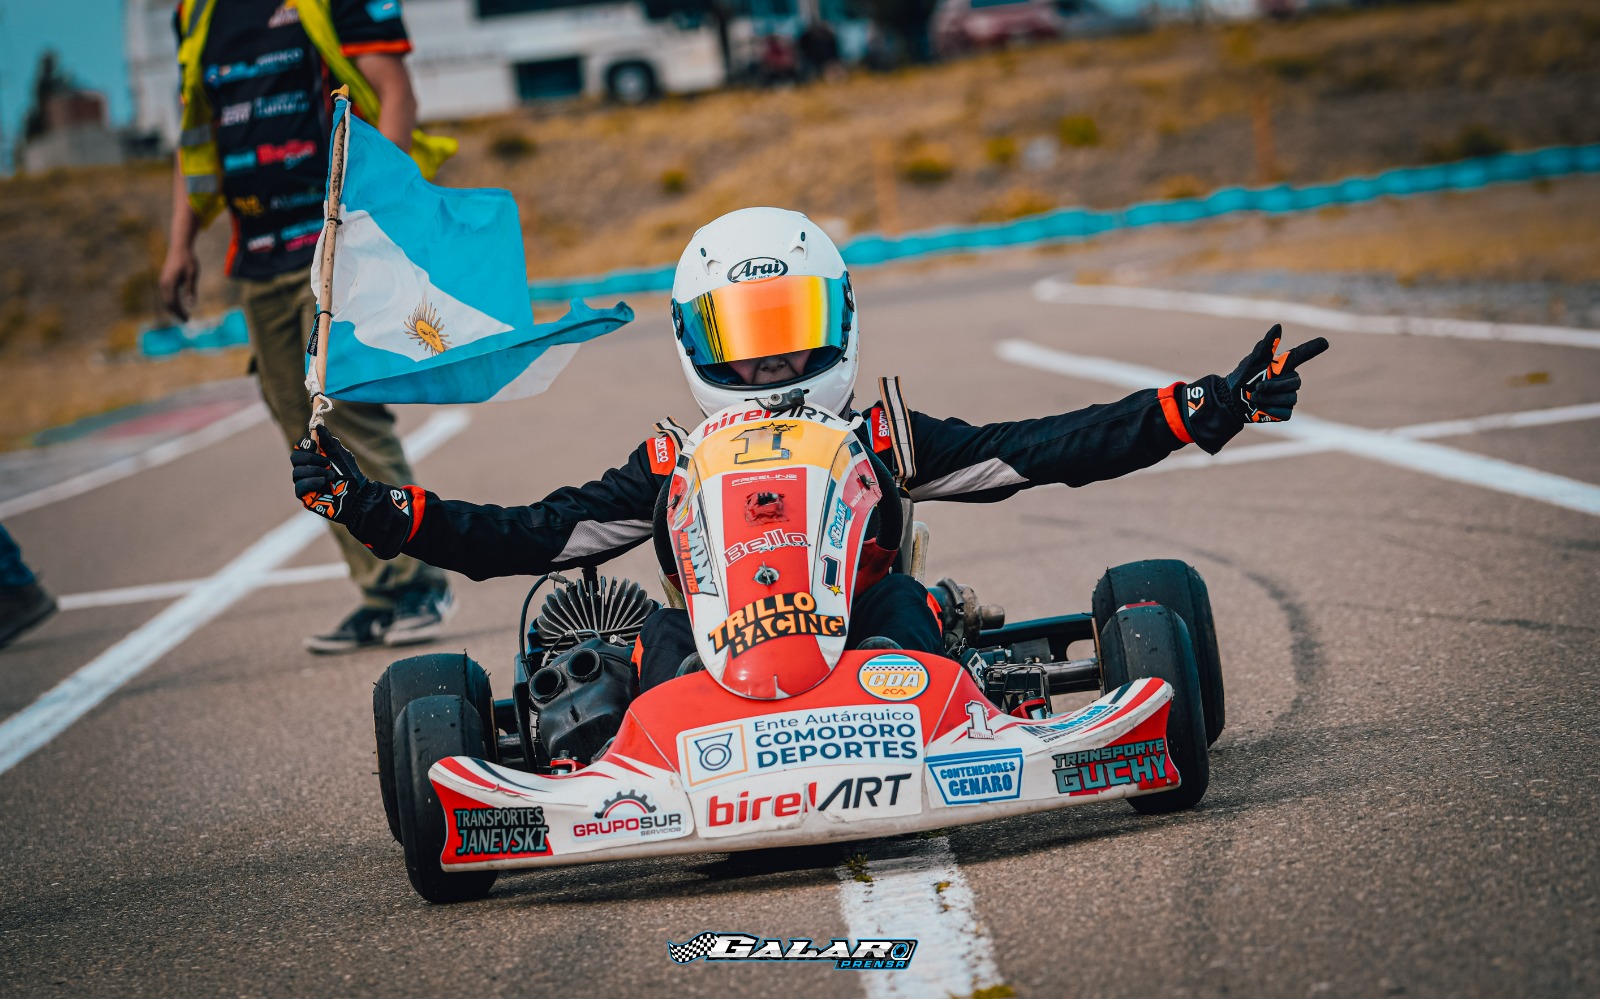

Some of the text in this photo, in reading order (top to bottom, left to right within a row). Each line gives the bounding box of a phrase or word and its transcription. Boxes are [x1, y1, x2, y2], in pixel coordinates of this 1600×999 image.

[732, 260, 782, 280] Arai
[731, 474, 798, 486] FREELINE
[724, 528, 808, 567] Bello
[683, 559, 699, 594] MOTOS
[821, 554, 842, 588] 1
[708, 592, 816, 651] TRILLO
[733, 615, 845, 657] RACING
[868, 673, 920, 687] CDA
[754, 710, 913, 732] Ente Autárquico
[755, 723, 916, 748] COMODORO
[757, 740, 918, 768] DEPORTES
[1053, 738, 1165, 768] TRANSPORTE
[940, 761, 1016, 780] CONTENEDORES
[1053, 754, 1167, 795] GUCHY
[948, 774, 1014, 797] GENARO
[455, 808, 545, 827] TRANSPORTES
[456, 825, 549, 855] JANEVSKI
[640, 827, 682, 836] SERVICIOS
